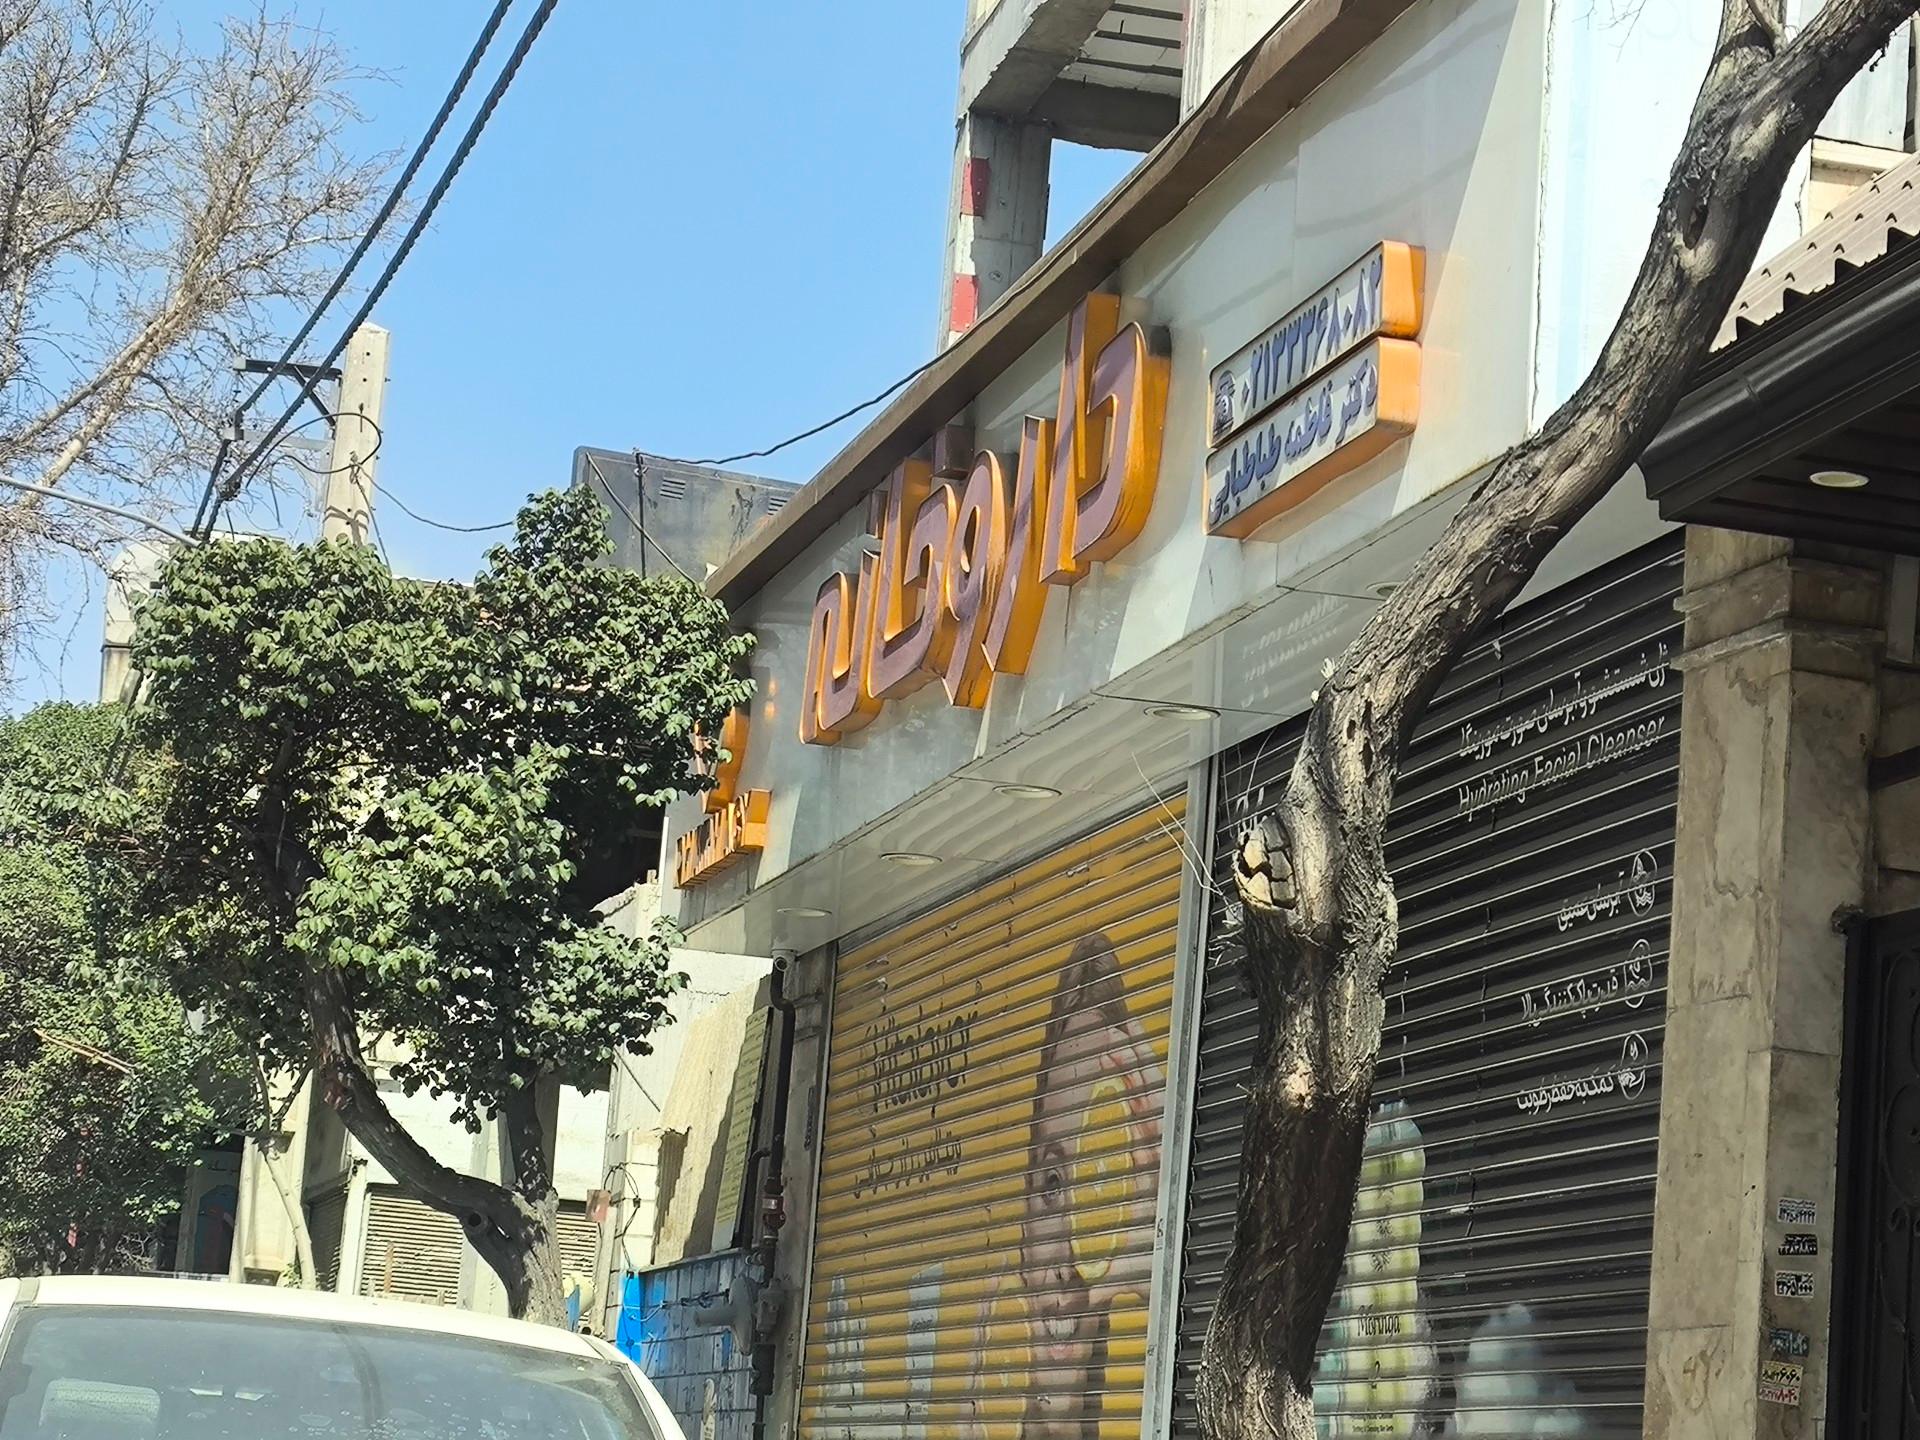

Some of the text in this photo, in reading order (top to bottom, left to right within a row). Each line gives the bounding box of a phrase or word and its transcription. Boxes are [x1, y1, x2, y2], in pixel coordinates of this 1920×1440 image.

[1208, 357, 1378, 525] دکتر فاطمه طباطبایی
[800, 292, 1168, 746] داروخانه
[1648, 642, 1669, 688] ژل
[1536, 670, 1581, 734] آبرسان
[1500, 708, 1537, 748] صورت
[1458, 715, 1666, 822] Hydrating Facial Cleanser
[1587, 870, 1625, 921] آبرسان
[1520, 991, 1538, 1028] بالا
[1589, 967, 1620, 1012] قدرت
[1357, 1303, 1401, 1343] Moringa
